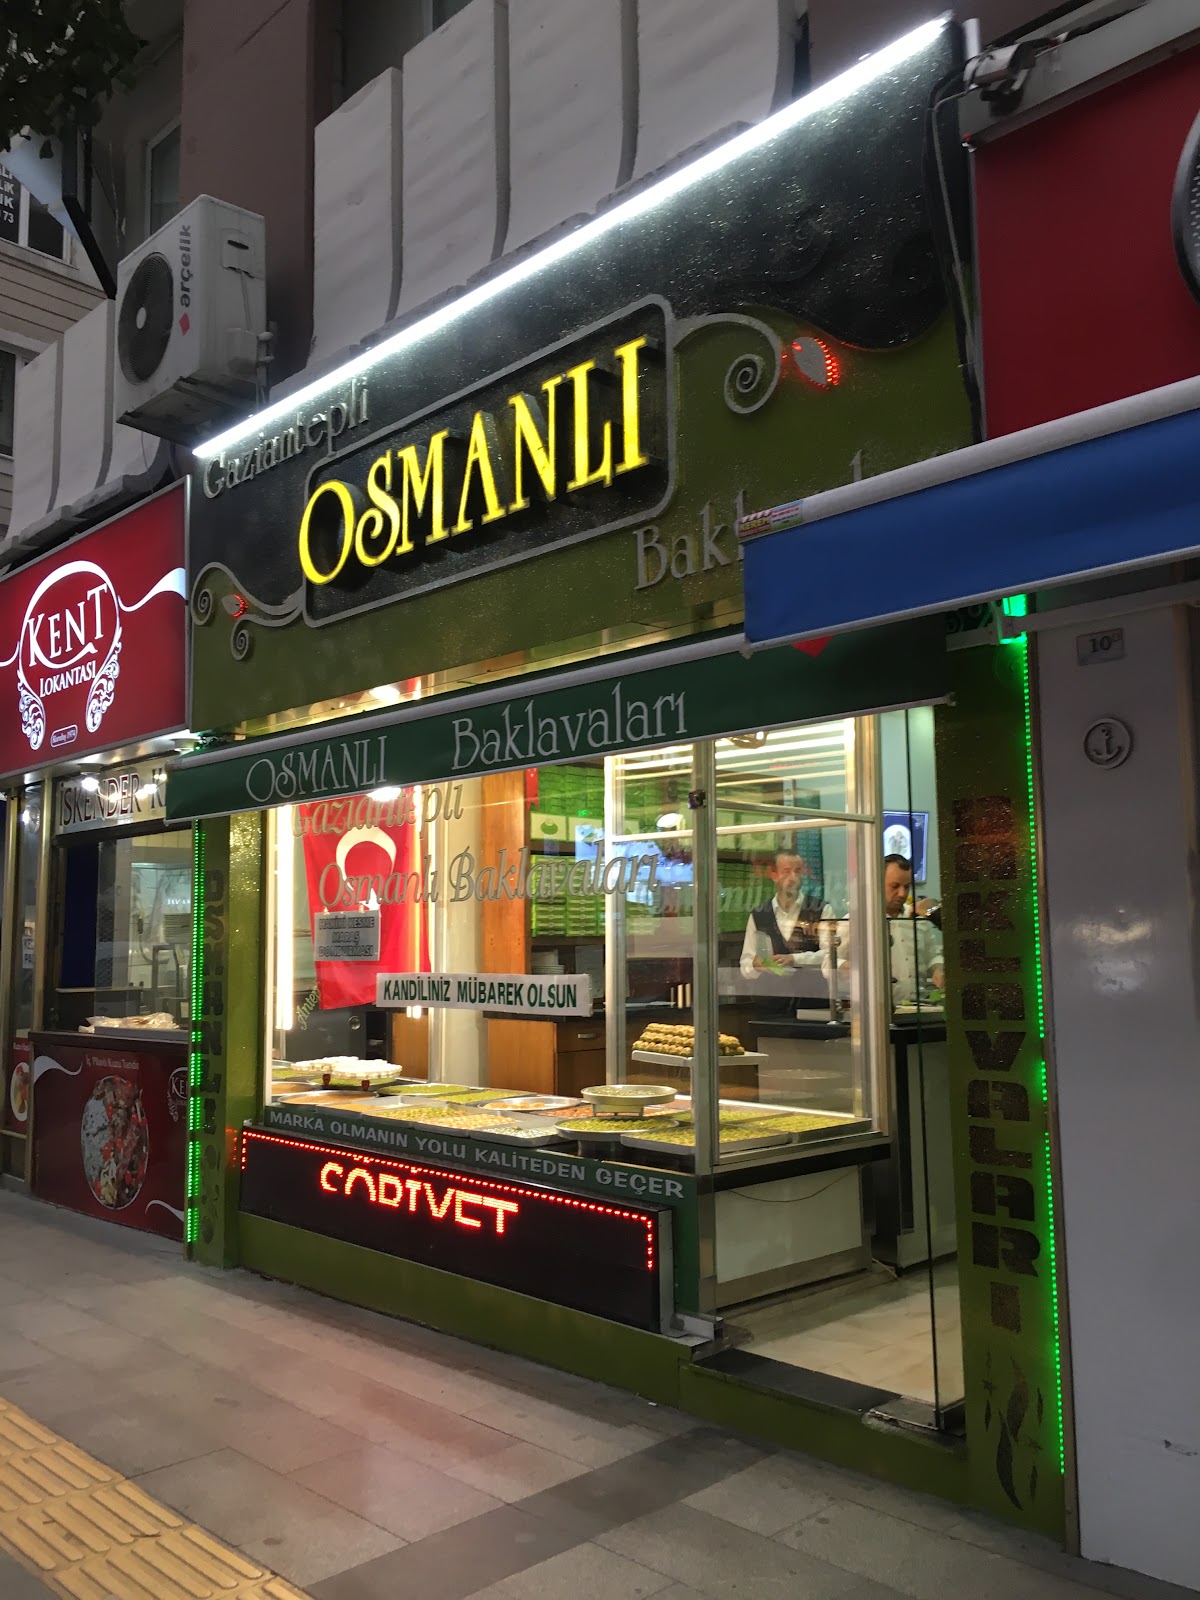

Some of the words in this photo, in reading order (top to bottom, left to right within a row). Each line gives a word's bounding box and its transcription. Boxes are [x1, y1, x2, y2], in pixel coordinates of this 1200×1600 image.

[179, 223, 194, 309] arçelik
[202, 374, 371, 500] Gaziantepli
[298, 335, 651, 586] OSMANLI
[27, 582, 108, 667] KENT
[39, 660, 98, 698] LOKANTASI
[450, 681, 688, 771] Baklavaları
[244, 734, 388, 803] OSMANLI
[318, 854, 438, 908] Osmanlı
[448, 839, 661, 904] Baklavaları
[318, 945, 374, 958] DONDURMASI
[347, 916, 375, 929] KESME
[383, 976, 452, 1003] KANDİLİNİZ
[456, 976, 524, 1007] MÜBAREK
[526, 984, 578, 1009] OLSUN
[269, 1110, 325, 1132] MARKA
[330, 1120, 409, 1148] OLMANIN
[414, 1135, 467, 1159] YOLU
[474, 1147, 586, 1181] KALİTEDEN
[595, 1167, 685, 1200] GEÇER
